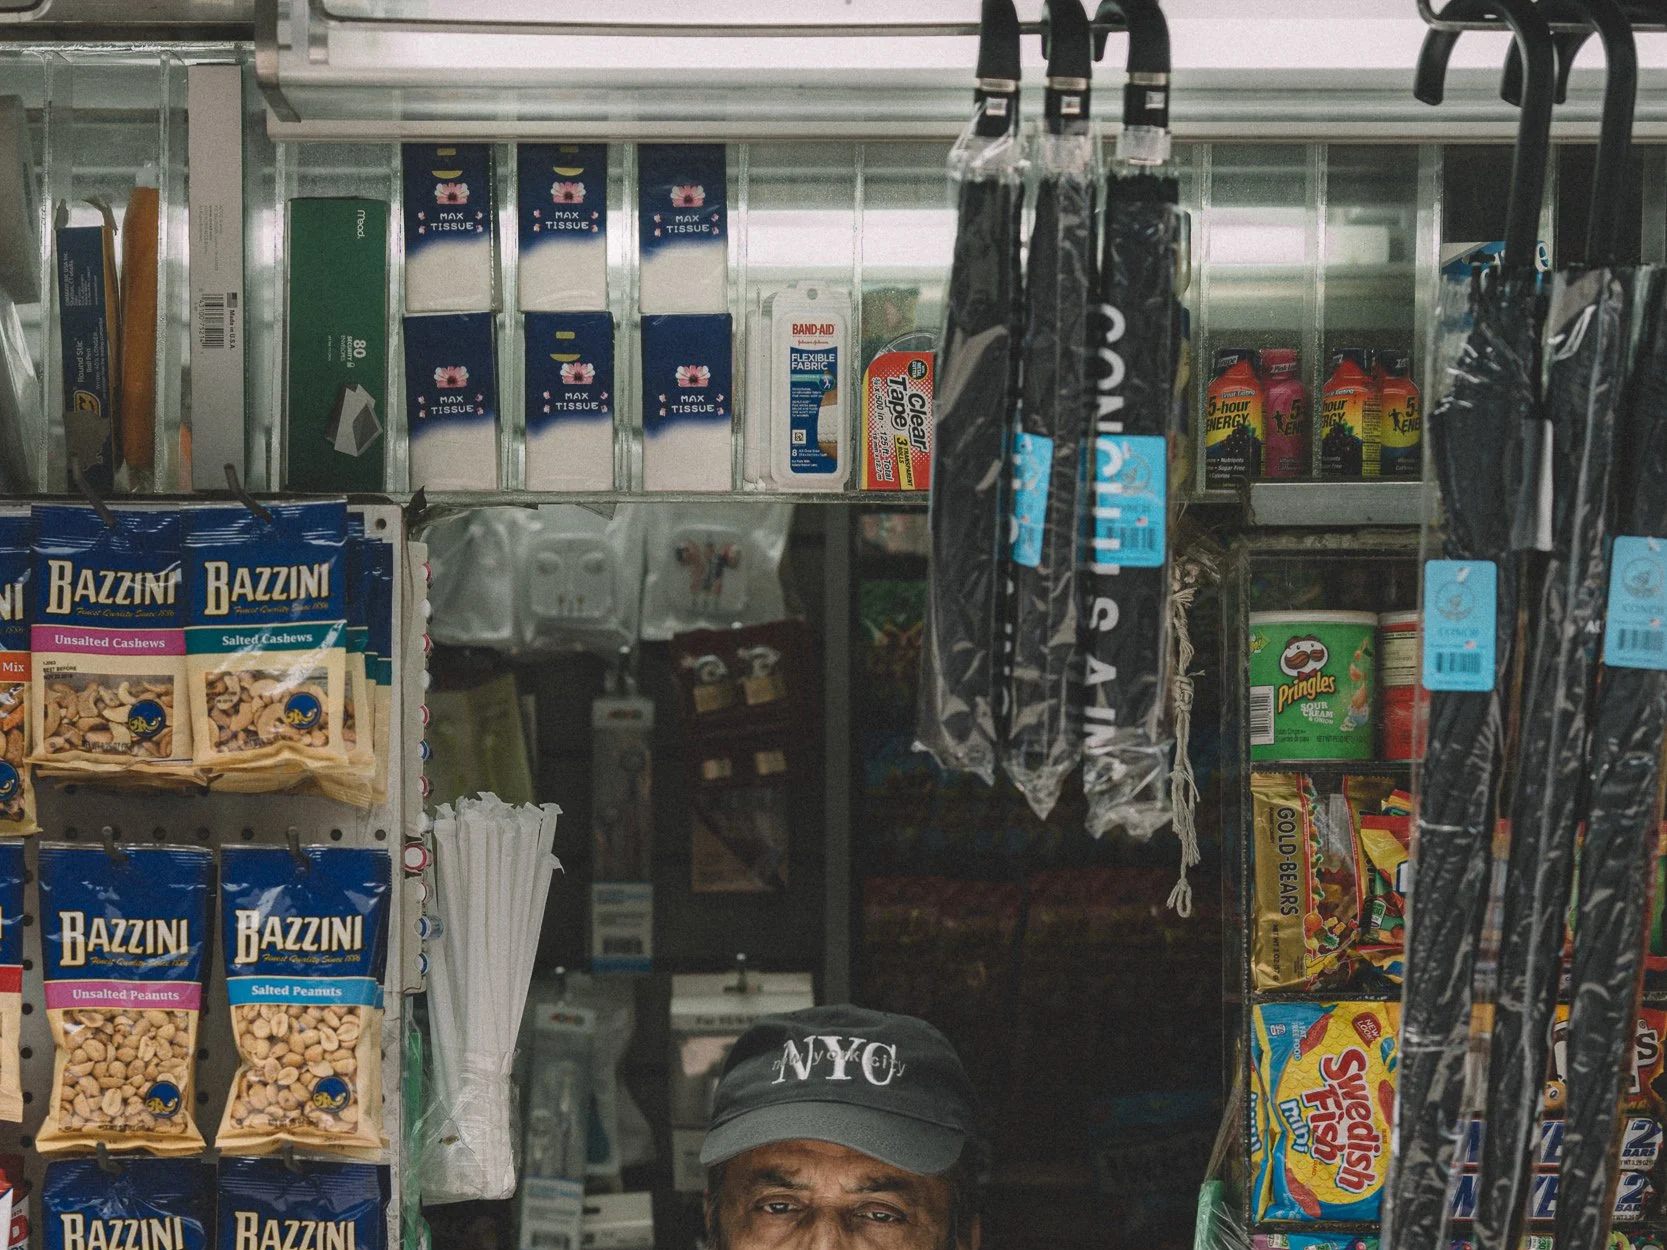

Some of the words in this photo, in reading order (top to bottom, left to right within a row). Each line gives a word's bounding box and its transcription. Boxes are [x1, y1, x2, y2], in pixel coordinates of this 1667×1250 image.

[439, 212, 464, 221] MAX
[554, 211, 580, 220] MAX
[675, 214, 700, 223] MAX
[430, 222, 474, 232] TISSUE
[545, 221, 589, 231] TISSUE
[666, 224, 710, 234] TISSUE
[791, 323, 835, 335] BAND-AID
[353, 338, 367, 359] 80
[791, 353, 835, 362] FLEXIBLE
[791, 362, 828, 371] FABRIC
[439, 395, 464, 404] MAX
[564, 392, 589, 401] MAX
[680, 394, 705, 403] MAX
[886, 376, 909, 430] Tape
[430, 405, 474, 415] TISSUE
[555, 402, 599, 411] TISSUE
[671, 403, 715, 413] TISSUE
[1208, 396, 1251, 417] 5-hour
[874, 394, 885, 410] 500
[880, 432, 888, 446] 125
[908, 393, 928, 452] Clear
[903, 447, 914, 488] TRANSPARENT
[46, 559, 177, 616] BAZZINI
[204, 560, 331, 617] BAZZINI
[54, 634, 109, 648] Unsalted
[112, 636, 166, 649] Cashews
[222, 634, 259, 646] Salted
[260, 632, 313, 644] Cashews
[2, 662, 25, 673] Mix
[1277, 671, 1336, 714] Pringles
[1300, 701, 1329, 710] SOUR
[1302, 710, 1334, 718] CREAM
[1277, 806, 1299, 917] GOLD-BEARS
[59, 910, 190, 968] BAZZINI
[234, 909, 363, 965] BAZZINI
[72, 988, 127, 1001] Unsalted
[129, 988, 180, 1001] Peanuts
[251, 984, 290, 997] Salted
[290, 986, 342, 997] Peanuts
[771, 1034, 897, 1086] NYC
[1301, 1083, 1342, 1165] Fish
[1321, 1045, 1378, 1194] Swedish
[1278, 1099, 1312, 1155] mini
[1622, 1147, 1657, 1157] BARS
